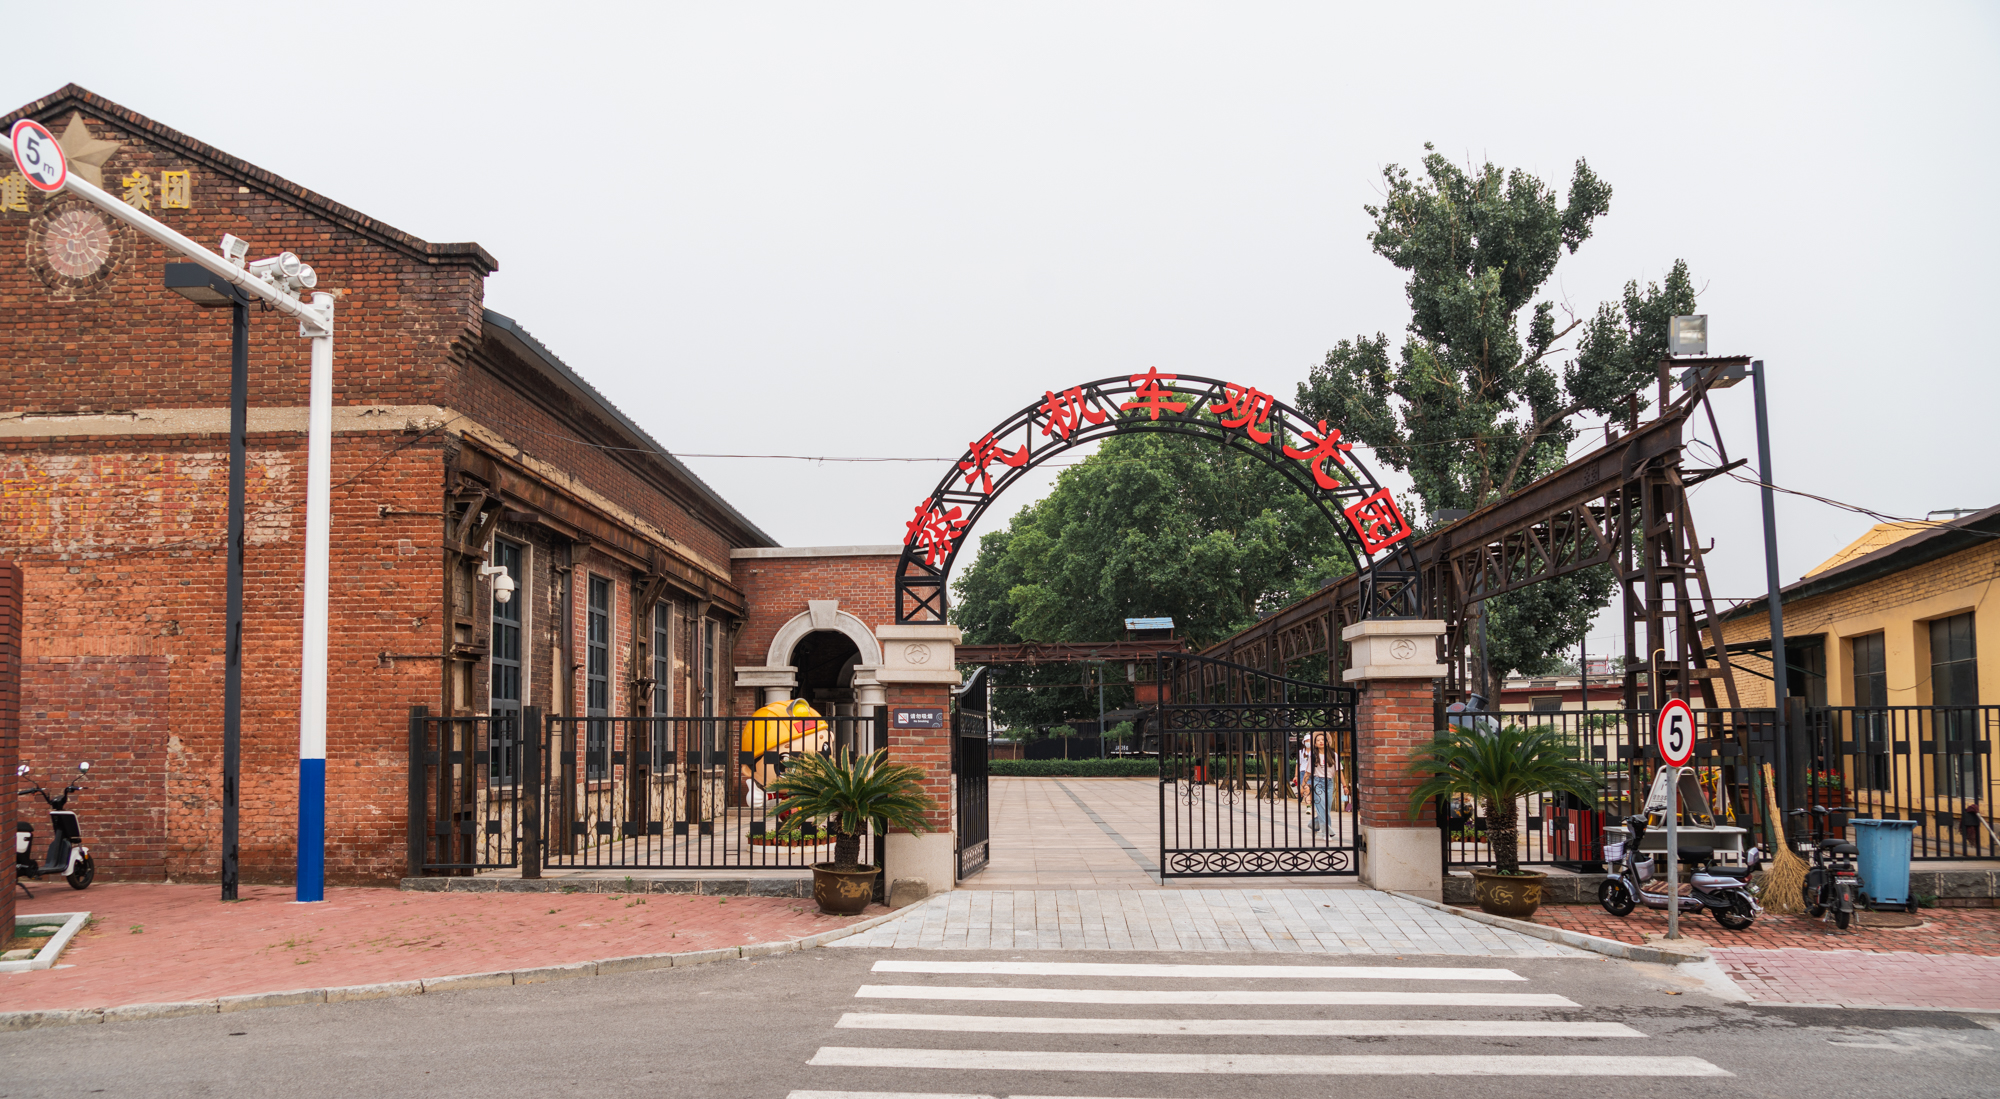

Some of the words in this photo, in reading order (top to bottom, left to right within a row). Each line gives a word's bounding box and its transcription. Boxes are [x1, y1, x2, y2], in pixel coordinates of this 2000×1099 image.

[26, 137, 41, 165] 5
[43, 161, 55, 176] m
[903, 366, 1412, 566] 蒸汽机车观光园
[1669, 715, 1683, 752] 5
